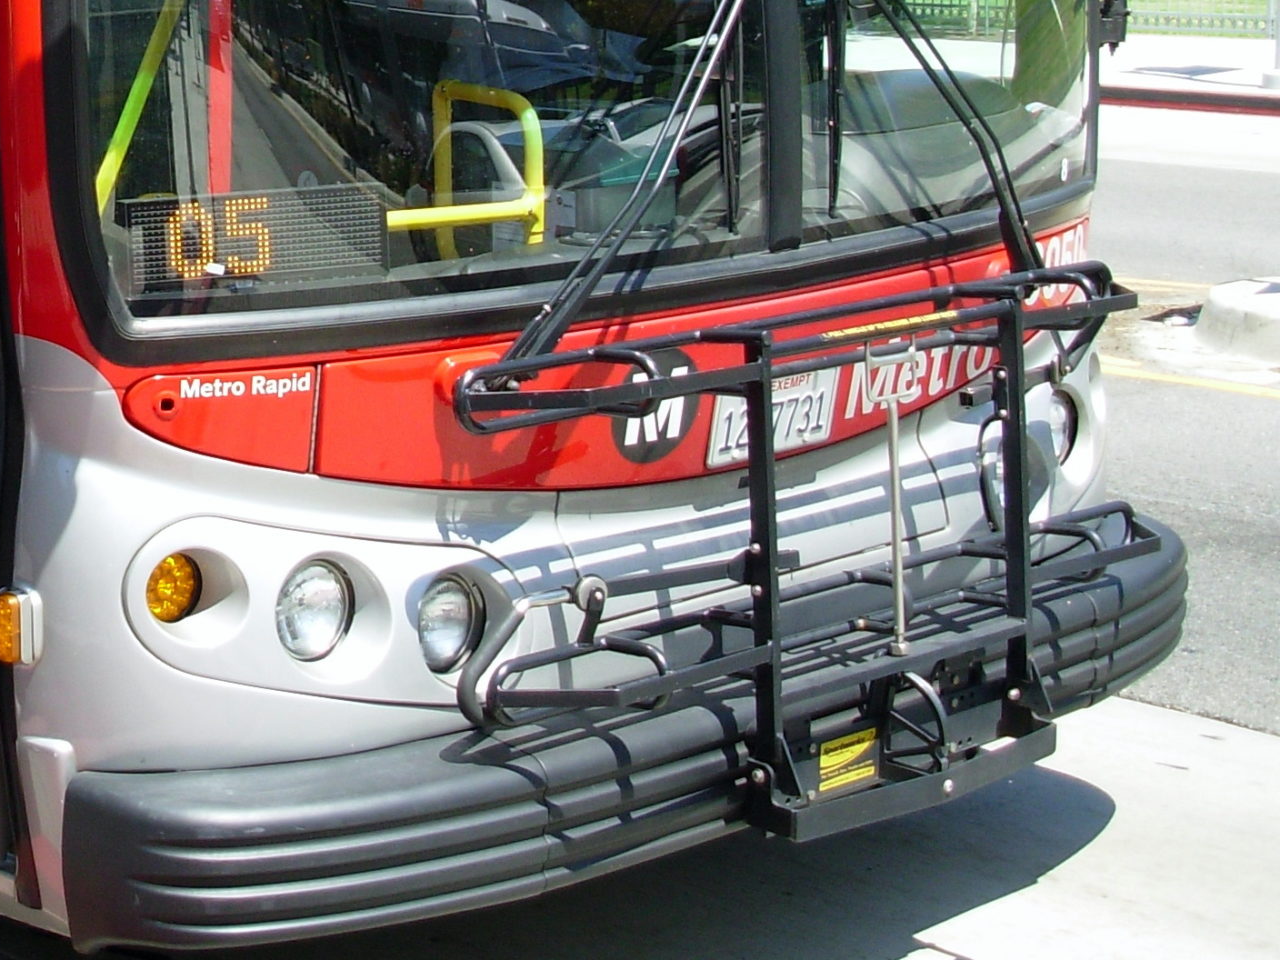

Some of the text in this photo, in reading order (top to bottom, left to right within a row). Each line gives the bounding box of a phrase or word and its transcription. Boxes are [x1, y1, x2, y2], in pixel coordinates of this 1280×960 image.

[169, 196, 269, 278] 05
[180, 372, 311, 398] Metro Rapid
[624, 366, 689, 446] M
[771, 373, 813, 392] EXEMPT
[844, 337, 994, 420] Metro
